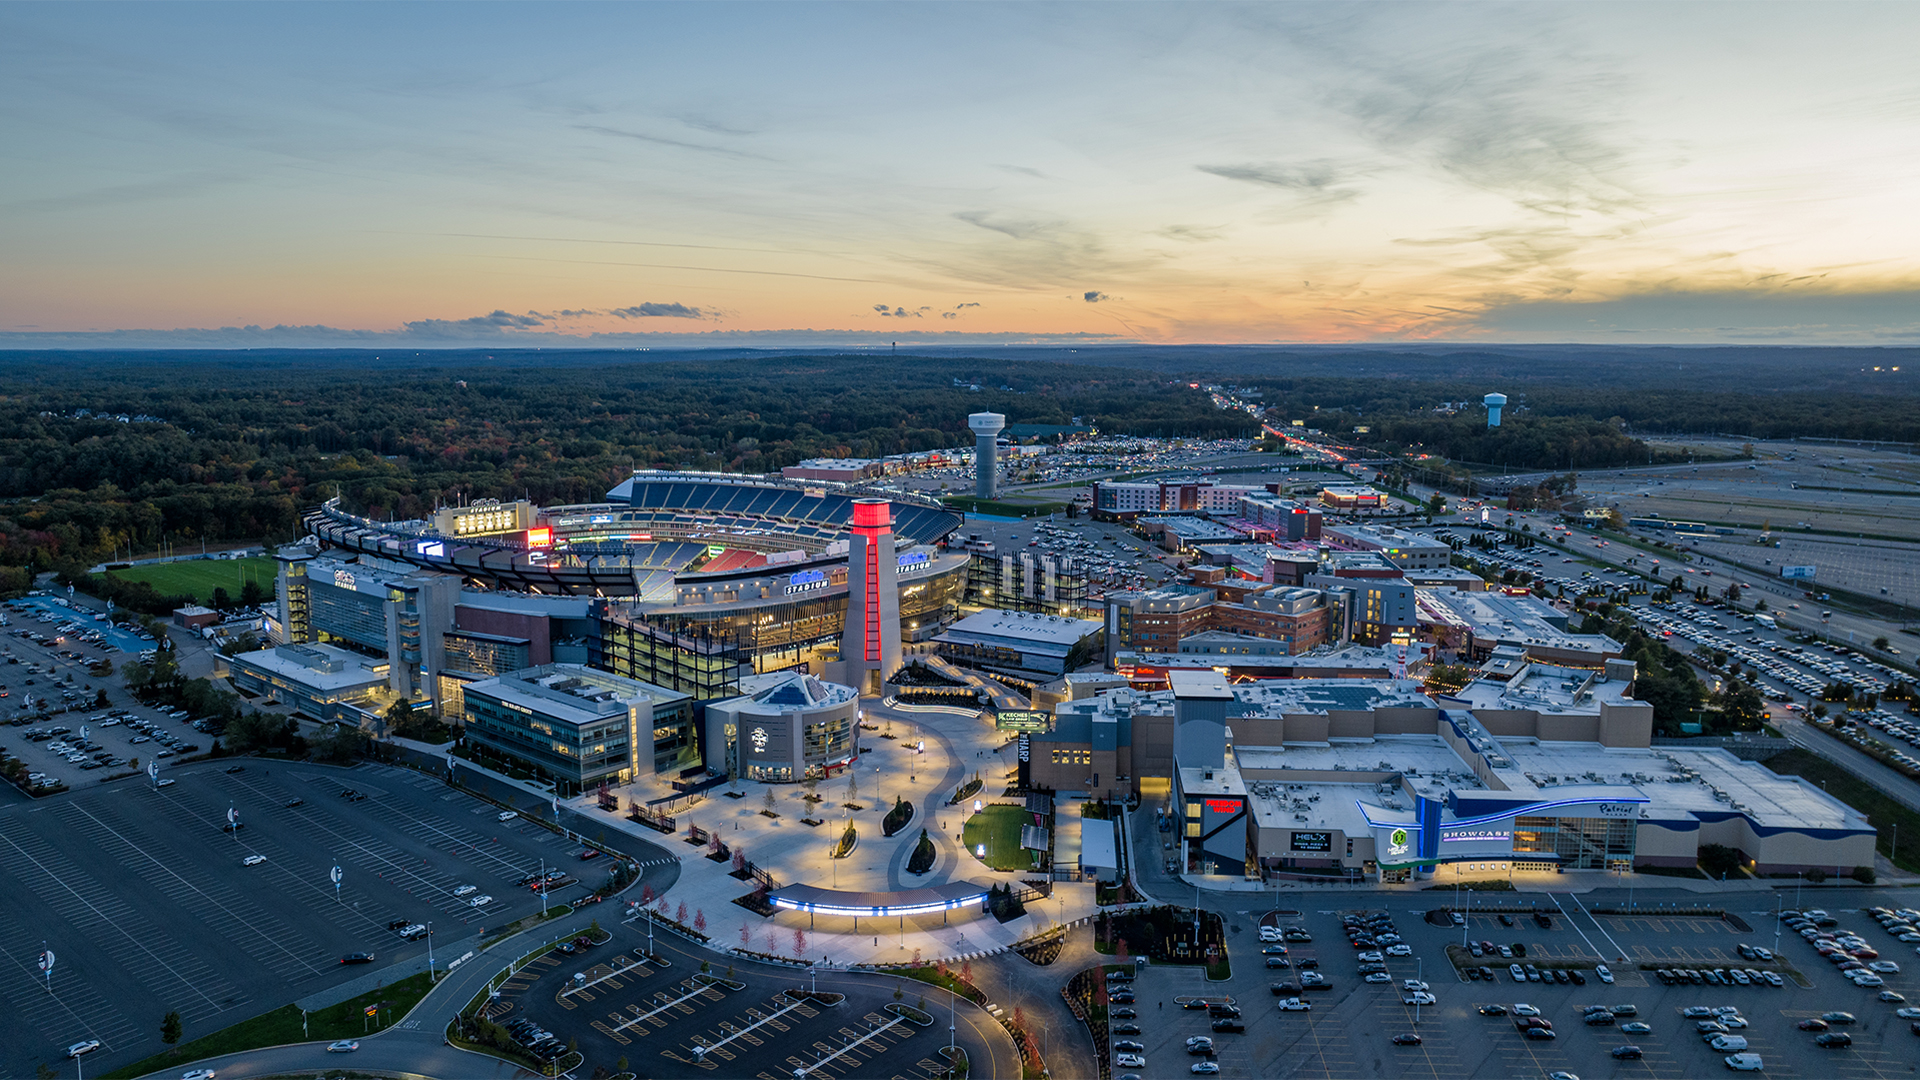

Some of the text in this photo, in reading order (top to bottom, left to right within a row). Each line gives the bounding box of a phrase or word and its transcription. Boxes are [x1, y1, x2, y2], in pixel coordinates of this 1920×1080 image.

[898, 552, 927, 565] Gillette
[895, 561, 931, 574] STADIUM
[790, 569, 824, 585] Gillette
[787, 580, 828, 594] STADIUM
[1019, 739, 1029, 763] HARP
[1206, 799, 1242, 807] FREEDOM
